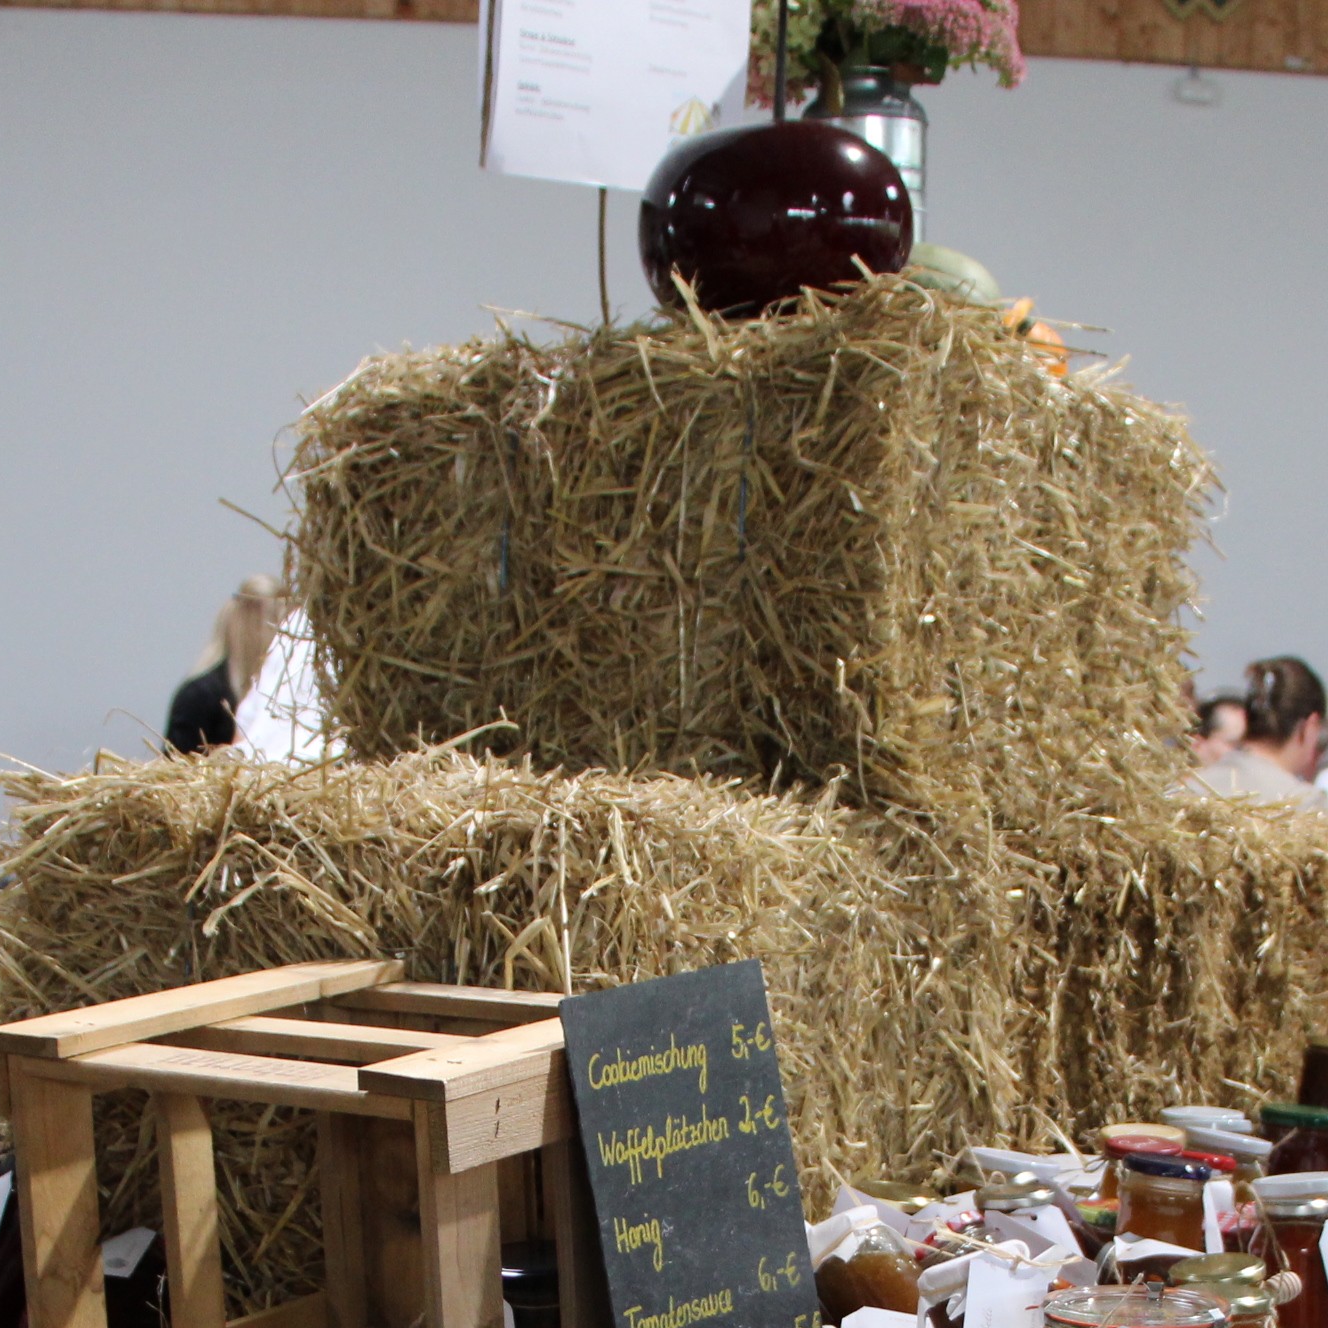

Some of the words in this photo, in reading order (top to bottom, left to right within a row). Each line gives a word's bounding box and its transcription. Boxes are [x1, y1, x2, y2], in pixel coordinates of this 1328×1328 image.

[589, 1033, 707, 1094] Cookiemischung
[598, 1103, 729, 1185] Waffelplätzchen
[614, 1212, 662, 1272] Honig
